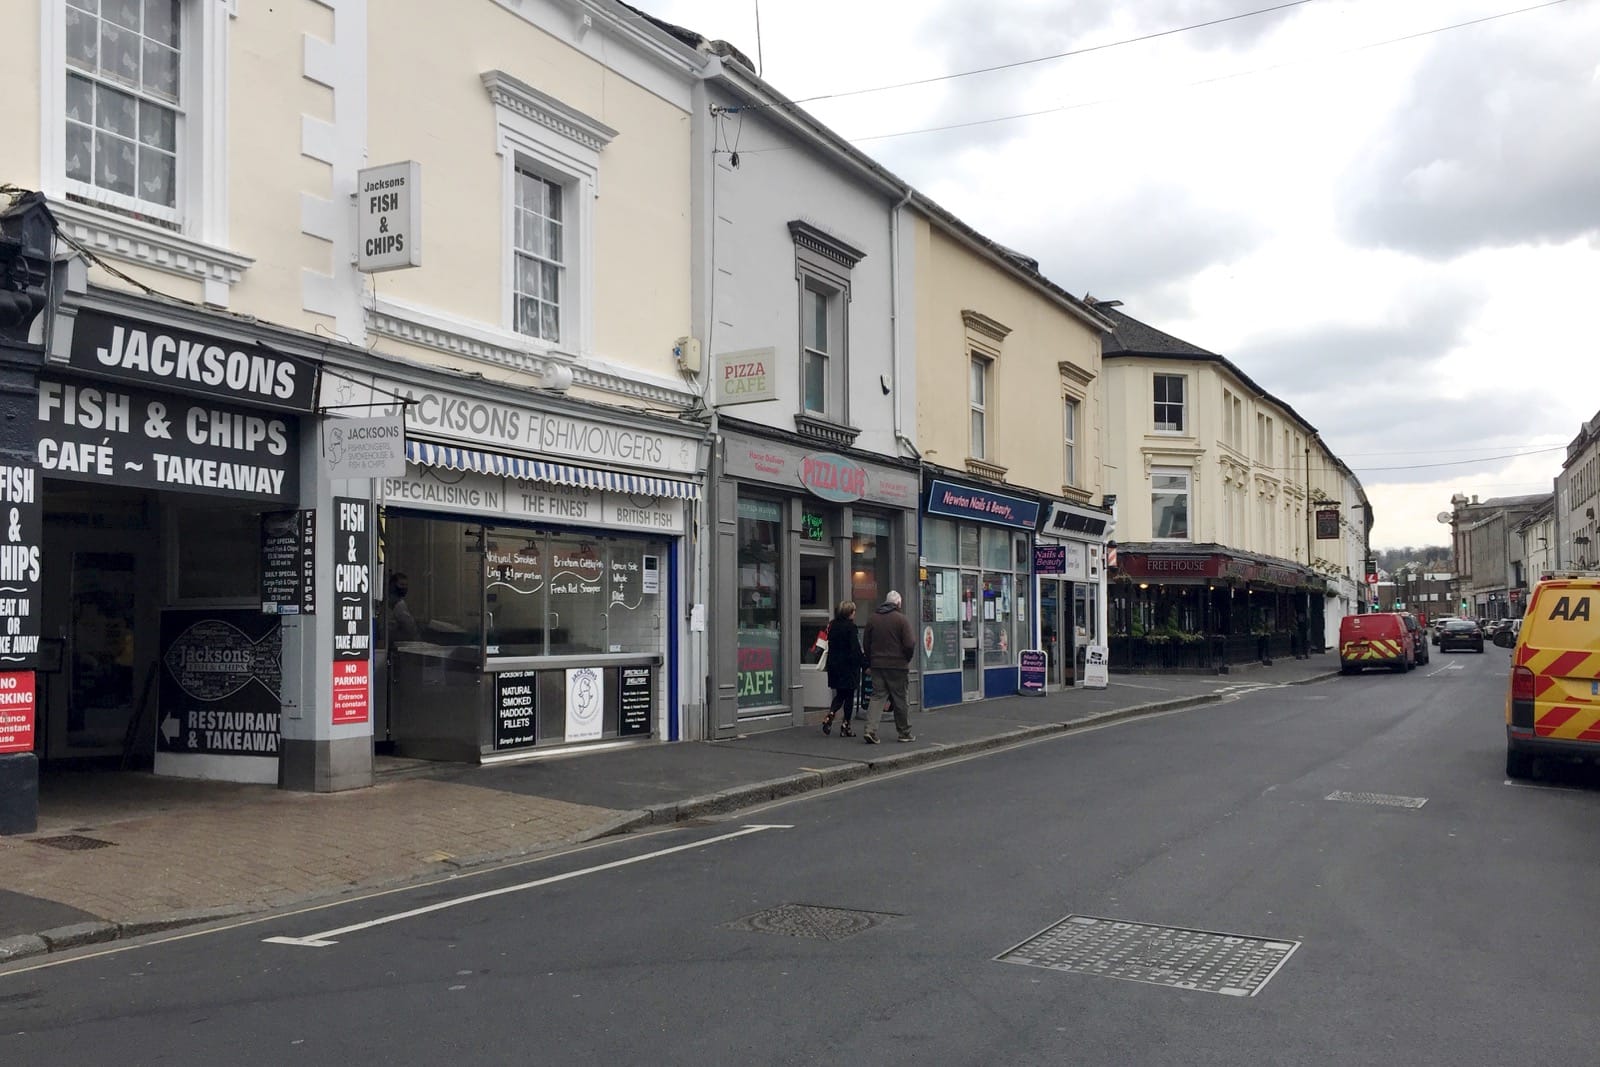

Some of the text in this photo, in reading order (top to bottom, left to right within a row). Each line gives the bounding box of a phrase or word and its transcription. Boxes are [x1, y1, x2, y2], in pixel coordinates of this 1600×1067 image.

[364, 175, 405, 192] Jacksons
[370, 192, 399, 215] FISH
[379, 216, 389, 234] &
[365, 233, 404, 258] CHIPS
[97, 325, 296, 399] JACKSONS
[724, 362, 765, 379] PIZZA
[724, 377, 766, 395] CAFE
[38, 380, 287, 456] FISH & CHIPS
[384, 388, 663, 463] JACKSONS FISHMONGERS
[348, 426, 399, 440] JACKSONS
[38, 437, 114, 476] CAFÉ
[153, 453, 285, 495] TAKEAWAY
[0, 466, 34, 503] FISH
[803, 457, 838, 490] PIZZA
[840, 467, 865, 497] CAFE
[385, 478, 498, 508] SPECIALISING IN
[521, 494, 589, 518] THE FINEST
[943, 491, 969, 507] Newton
[970, 496, 986, 511] Nails
[991, 501, 1012, 519] Beauty
[8, 507, 21, 542] &
[340, 502, 365, 532] FISH
[616, 506, 673, 528] BRITISH FISH
[305, 512, 313, 543] FISH
[348, 535, 356, 562] &
[1035, 550, 1064, 559] Nails &
[0, 545, 40, 582] HIPS
[486, 551, 537, 565] Natural Smoked
[1036, 558, 1064, 567] Beauty
[1147, 560, 1204, 571] FREE HOUSE
[304, 561, 313, 602] CHIPS
[336, 564, 368, 593] CHIPS
[487, 566, 501, 580] Ling
[514, 572, 524, 580] per
[524, 572, 542, 582] portion
[550, 583, 601, 595] Fresh Red Snapper
[0, 598, 30, 616] EAT IN
[342, 606, 362, 620] EAT IN
[1548, 596, 1590, 621] AA
[7, 617, 21, 635] OR
[348, 621, 356, 635] OR
[0, 635, 39, 653] KE AWAY
[335, 635, 368, 650] TAKE AWAY
[179, 646, 250, 666] Jacksons
[345, 664, 357, 673] NO
[571, 668, 597, 682] JACKSONS
[0, 678, 16, 689] NO
[334, 676, 367, 686] PARKING
[737, 671, 773, 697] CAFE
[0, 692, 32, 704] RKING
[338, 693, 363, 701] Entrance
[501, 686, 532, 696] NATURAL
[342, 700, 367, 709] constant
[502, 697, 531, 707] SMOKED
[345, 709, 356, 717] use
[500, 707, 533, 718] HADDOCK
[504, 718, 530, 729] FILLETS
[188, 731, 198, 748] &
